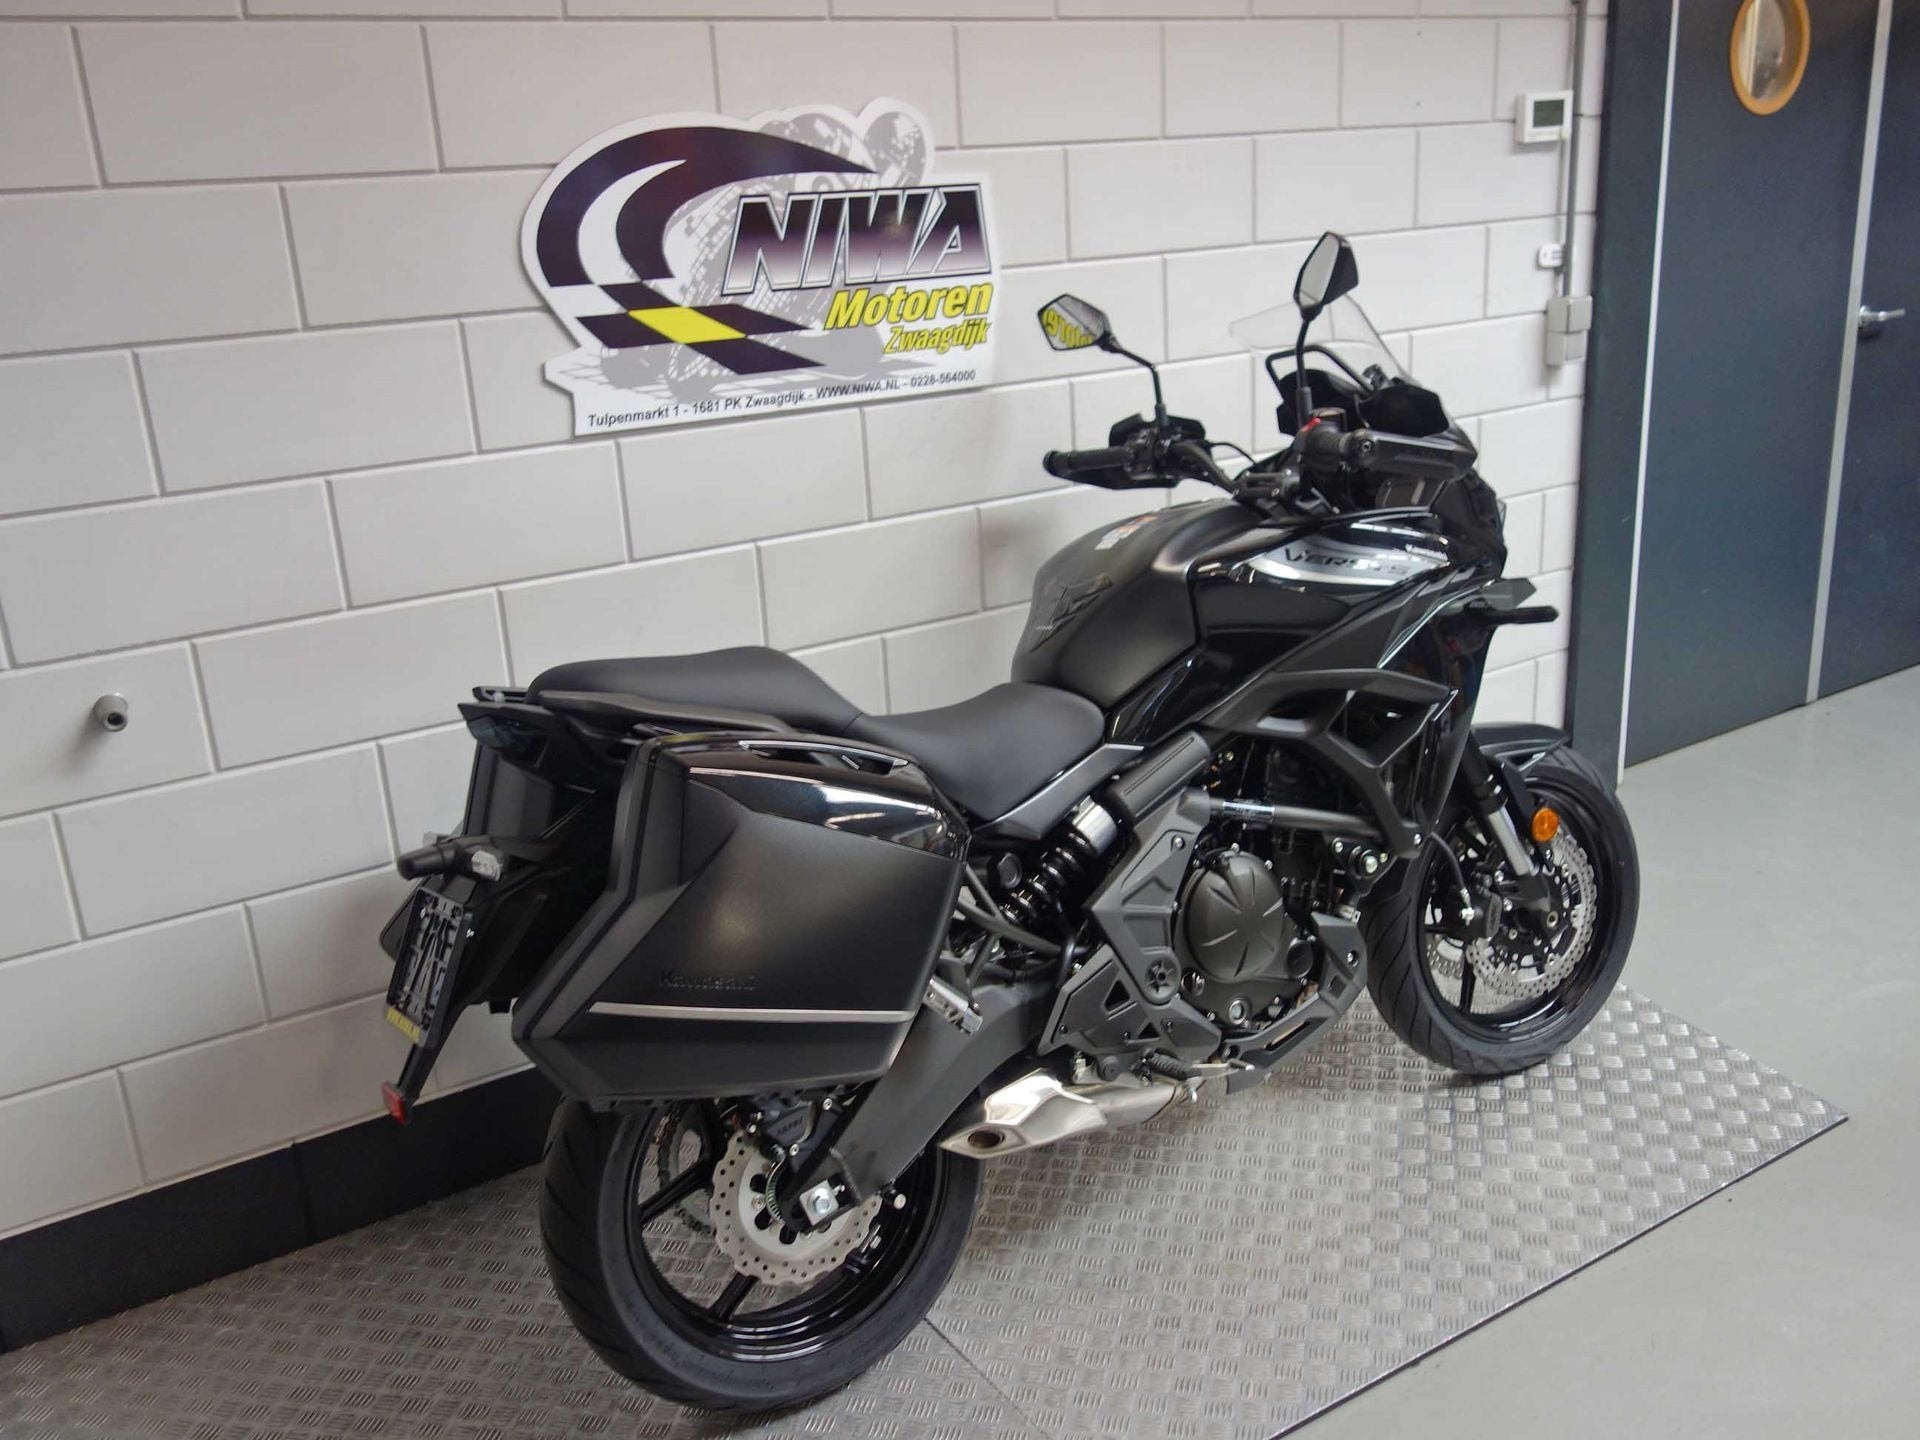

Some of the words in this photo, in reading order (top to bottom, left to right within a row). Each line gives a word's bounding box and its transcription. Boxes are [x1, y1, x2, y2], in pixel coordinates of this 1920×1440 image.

[721, 183, 991, 296] NIWA
[823, 282, 993, 330] Motoren
[883, 318, 990, 354] Zwaagdijk
[588, 409, 669, 427] Tulpenmarkt
[674, 405, 680, 418] 1
[694, 400, 720, 415] 1681
[724, 397, 742, 411] PK
[745, 390, 807, 409] Zwaagdijk
[816, 379, 900, 400] WWW.NIWA.NL
